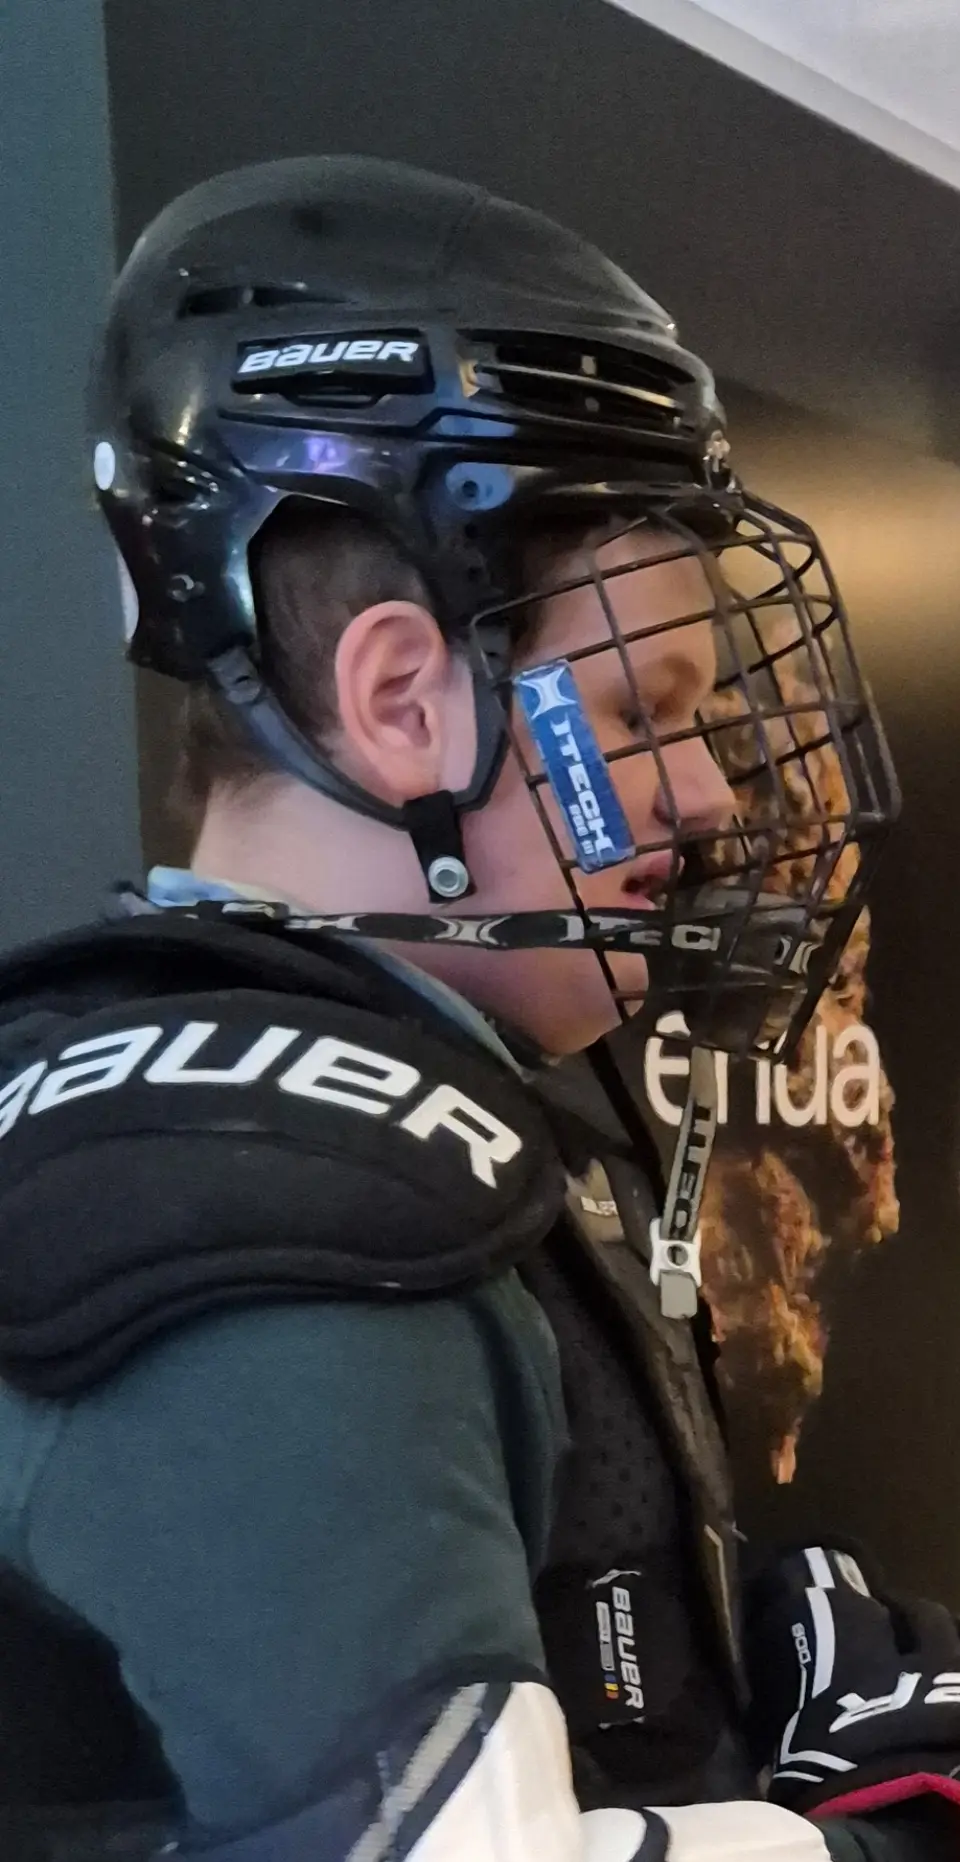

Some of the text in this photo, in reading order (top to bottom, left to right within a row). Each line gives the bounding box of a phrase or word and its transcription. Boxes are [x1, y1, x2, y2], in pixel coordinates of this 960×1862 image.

[237, 340, 419, 373] BAUER
[550, 712, 616, 860] ITECH
[611, 1585, 645, 1709] BAUER
